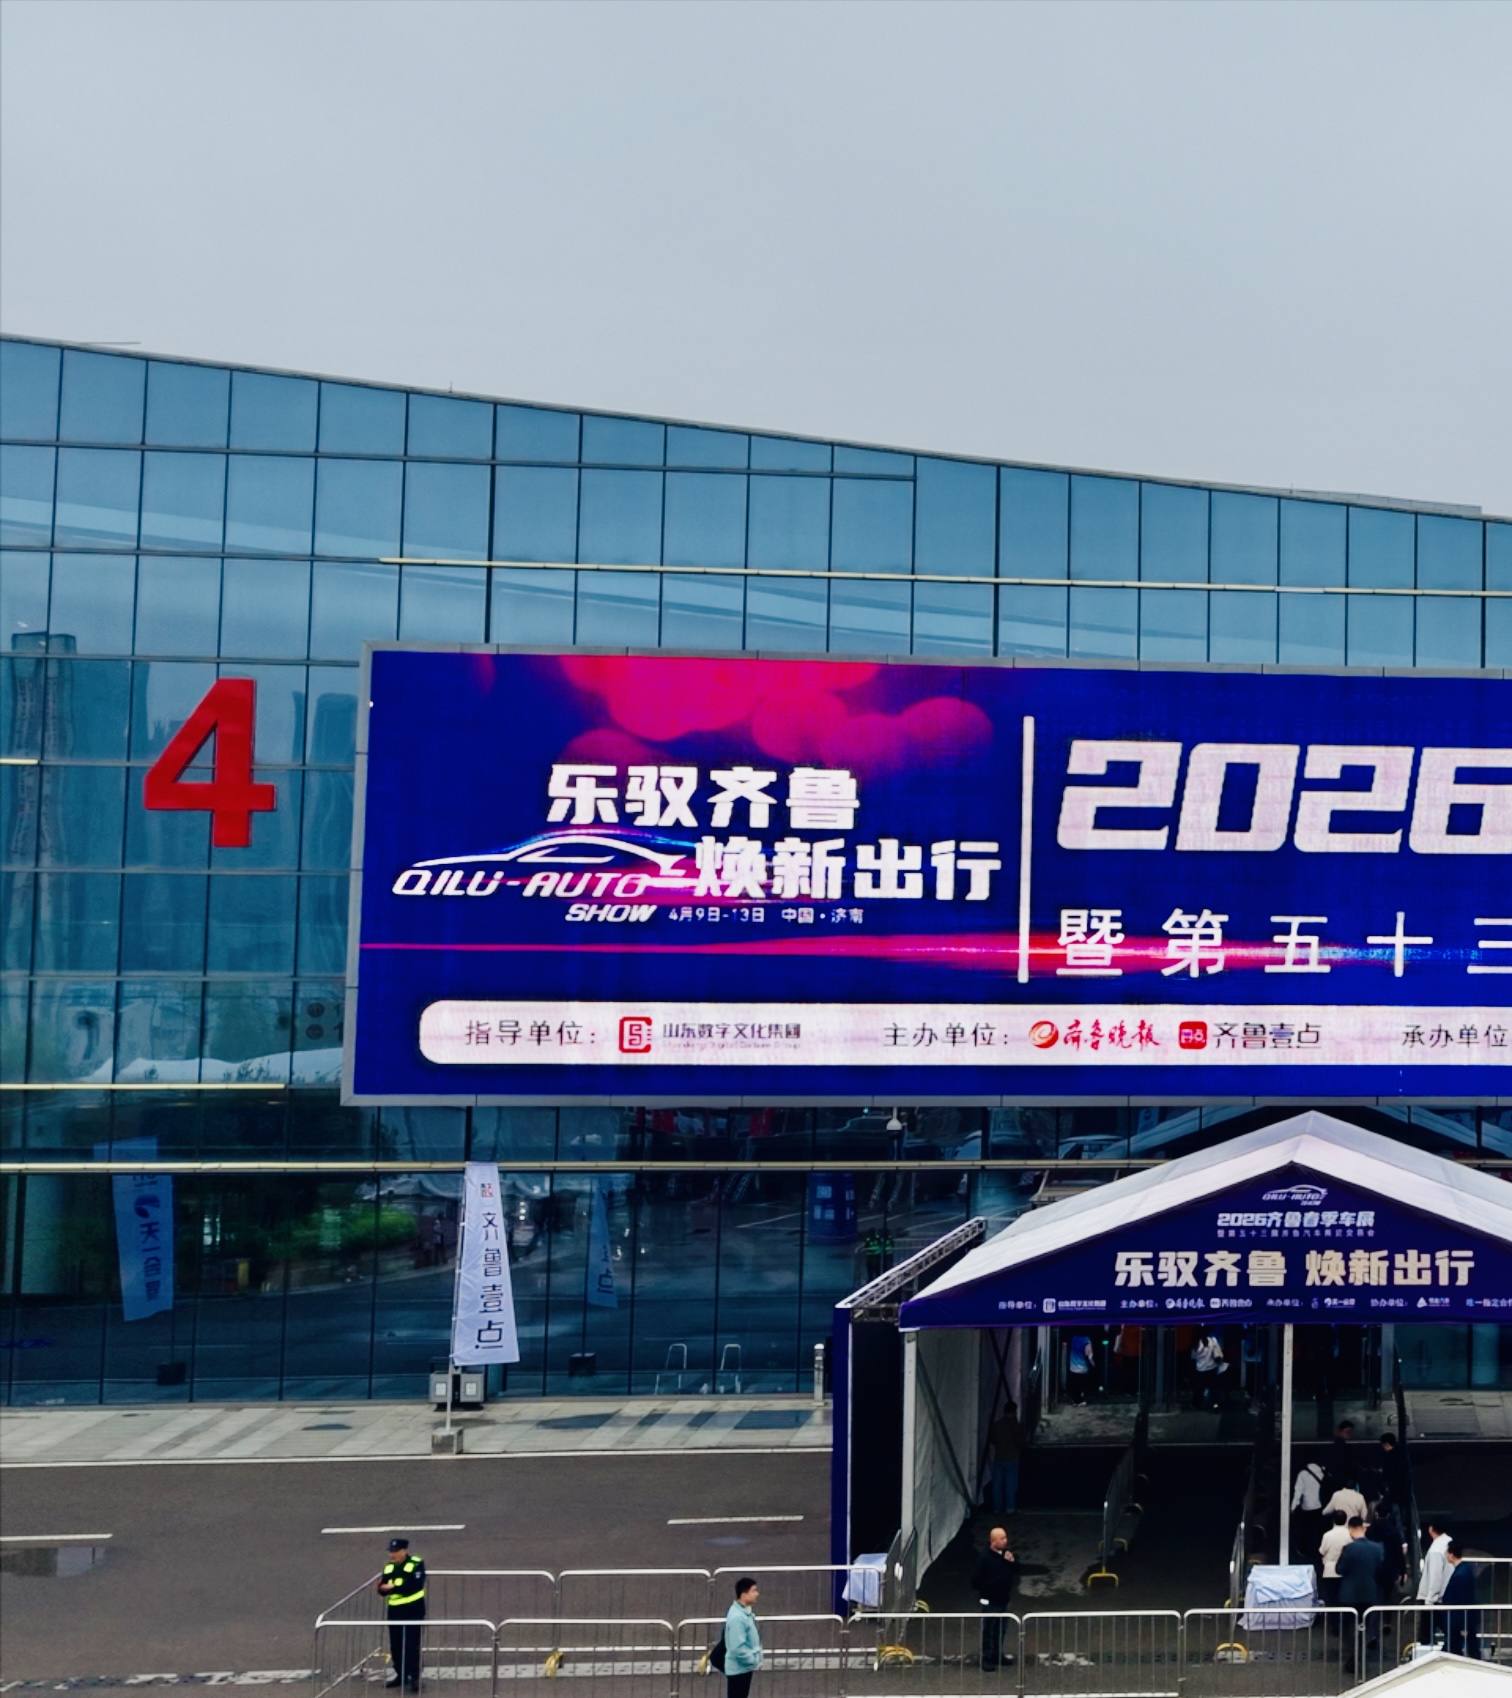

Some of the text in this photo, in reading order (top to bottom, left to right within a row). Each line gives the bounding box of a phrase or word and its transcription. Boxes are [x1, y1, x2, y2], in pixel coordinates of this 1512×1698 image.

[144, 677, 276, 848] 4
[546, 763, 860, 829] 乐驭齐鲁
[695, 834, 1002, 902] 焕新出行
[565, 903, 658, 922] SHOW
[668, 906, 765, 923] 4月9日-13日
[464, 1020, 596, 1047] 指导单位：
[882, 1021, 1009, 1049] 主办单位：
[1212, 1021, 1322, 1050] 齐鲁壹点
[1217, 1210, 1376, 1228] 2026齐鲁春季车展
[1114, 1249, 1476, 1288] 乐驭齐鲁 焕新出行
